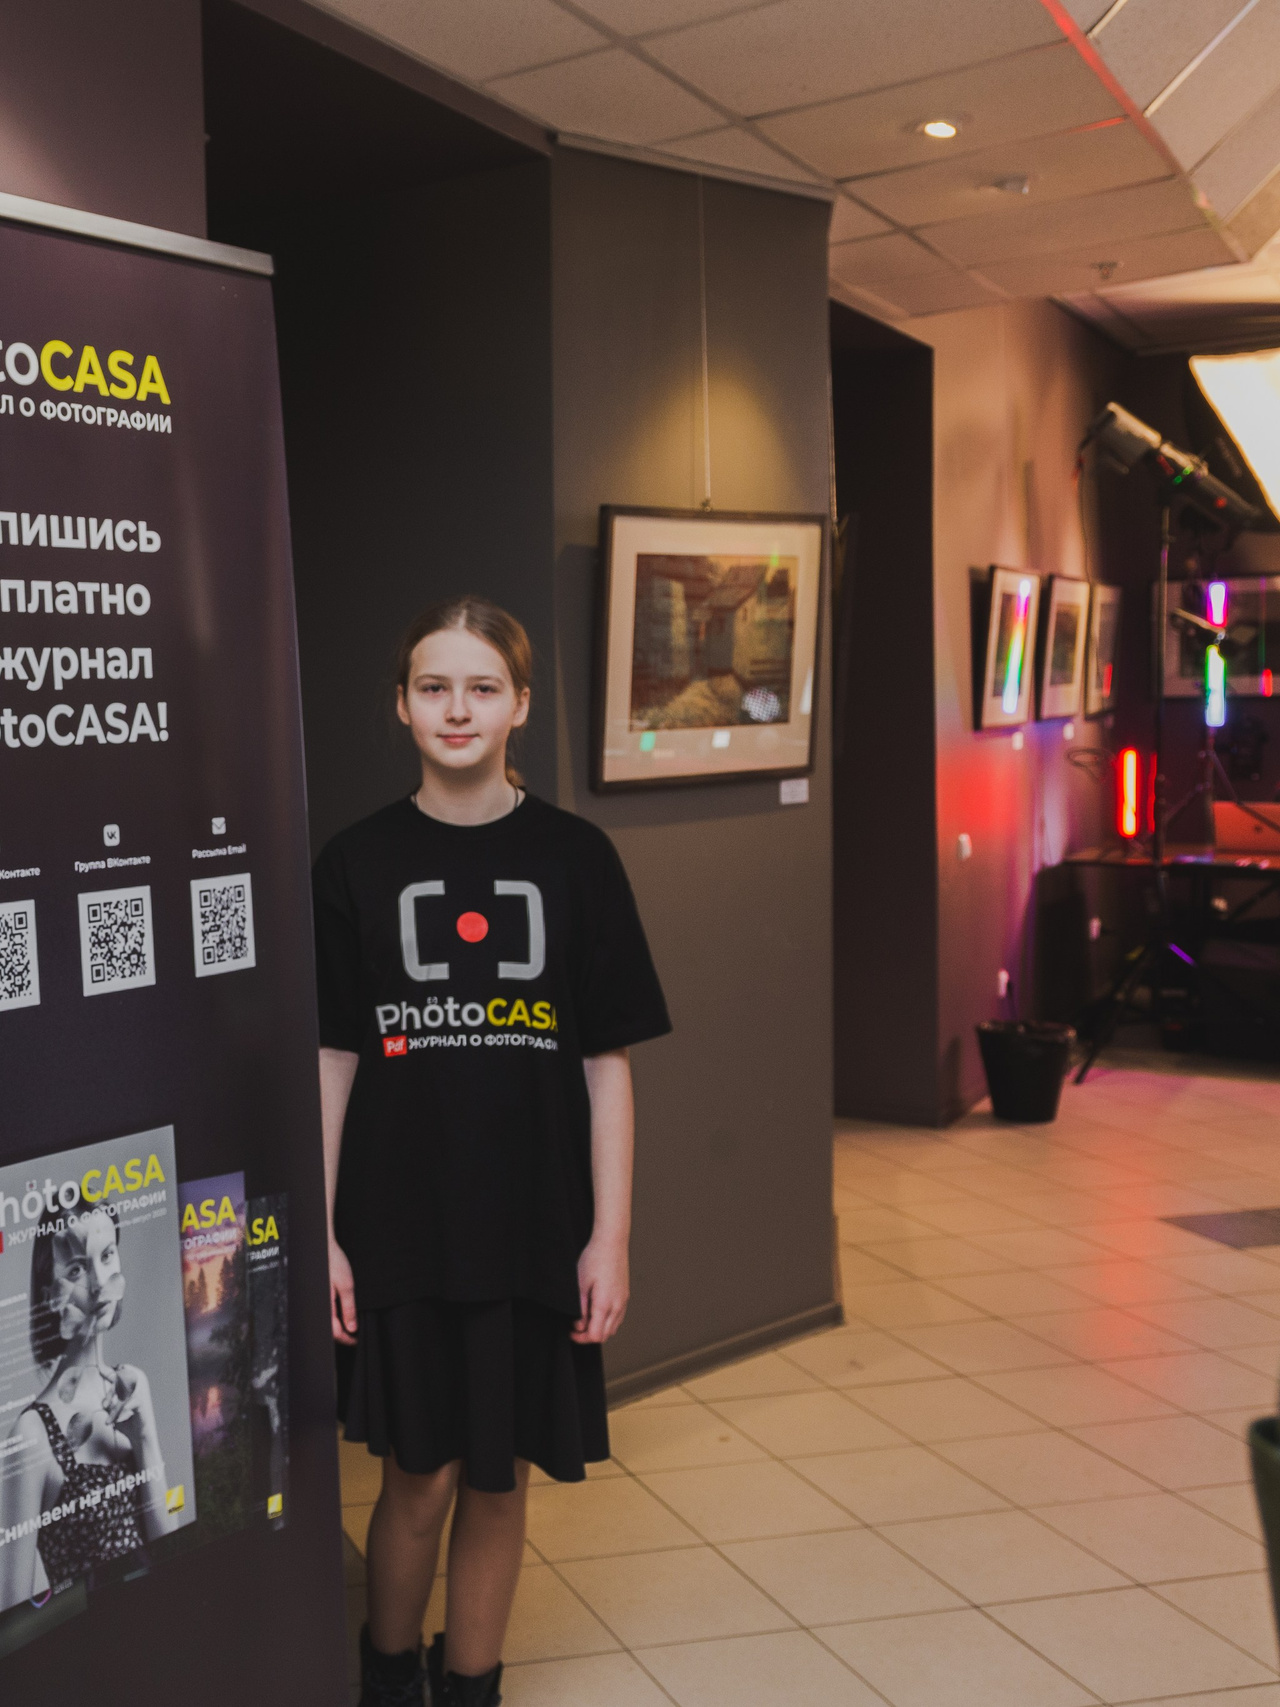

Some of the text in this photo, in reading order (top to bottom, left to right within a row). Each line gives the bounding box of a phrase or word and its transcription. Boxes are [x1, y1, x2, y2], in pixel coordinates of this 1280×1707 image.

[19, 397, 35, 418] О
[40, 399, 172, 434] ФОТОГРАФИИ
[74, 855, 151, 873] Группа ВКонтакте
[386, 1039, 404, 1053] Pdf
[408, 1034, 467, 1050] ЖУРНАЛ
[469, 1034, 482, 1047] О
[7, 1218, 65, 1247] ЖУРНАЛ
[78, 1488, 103, 1510] на
